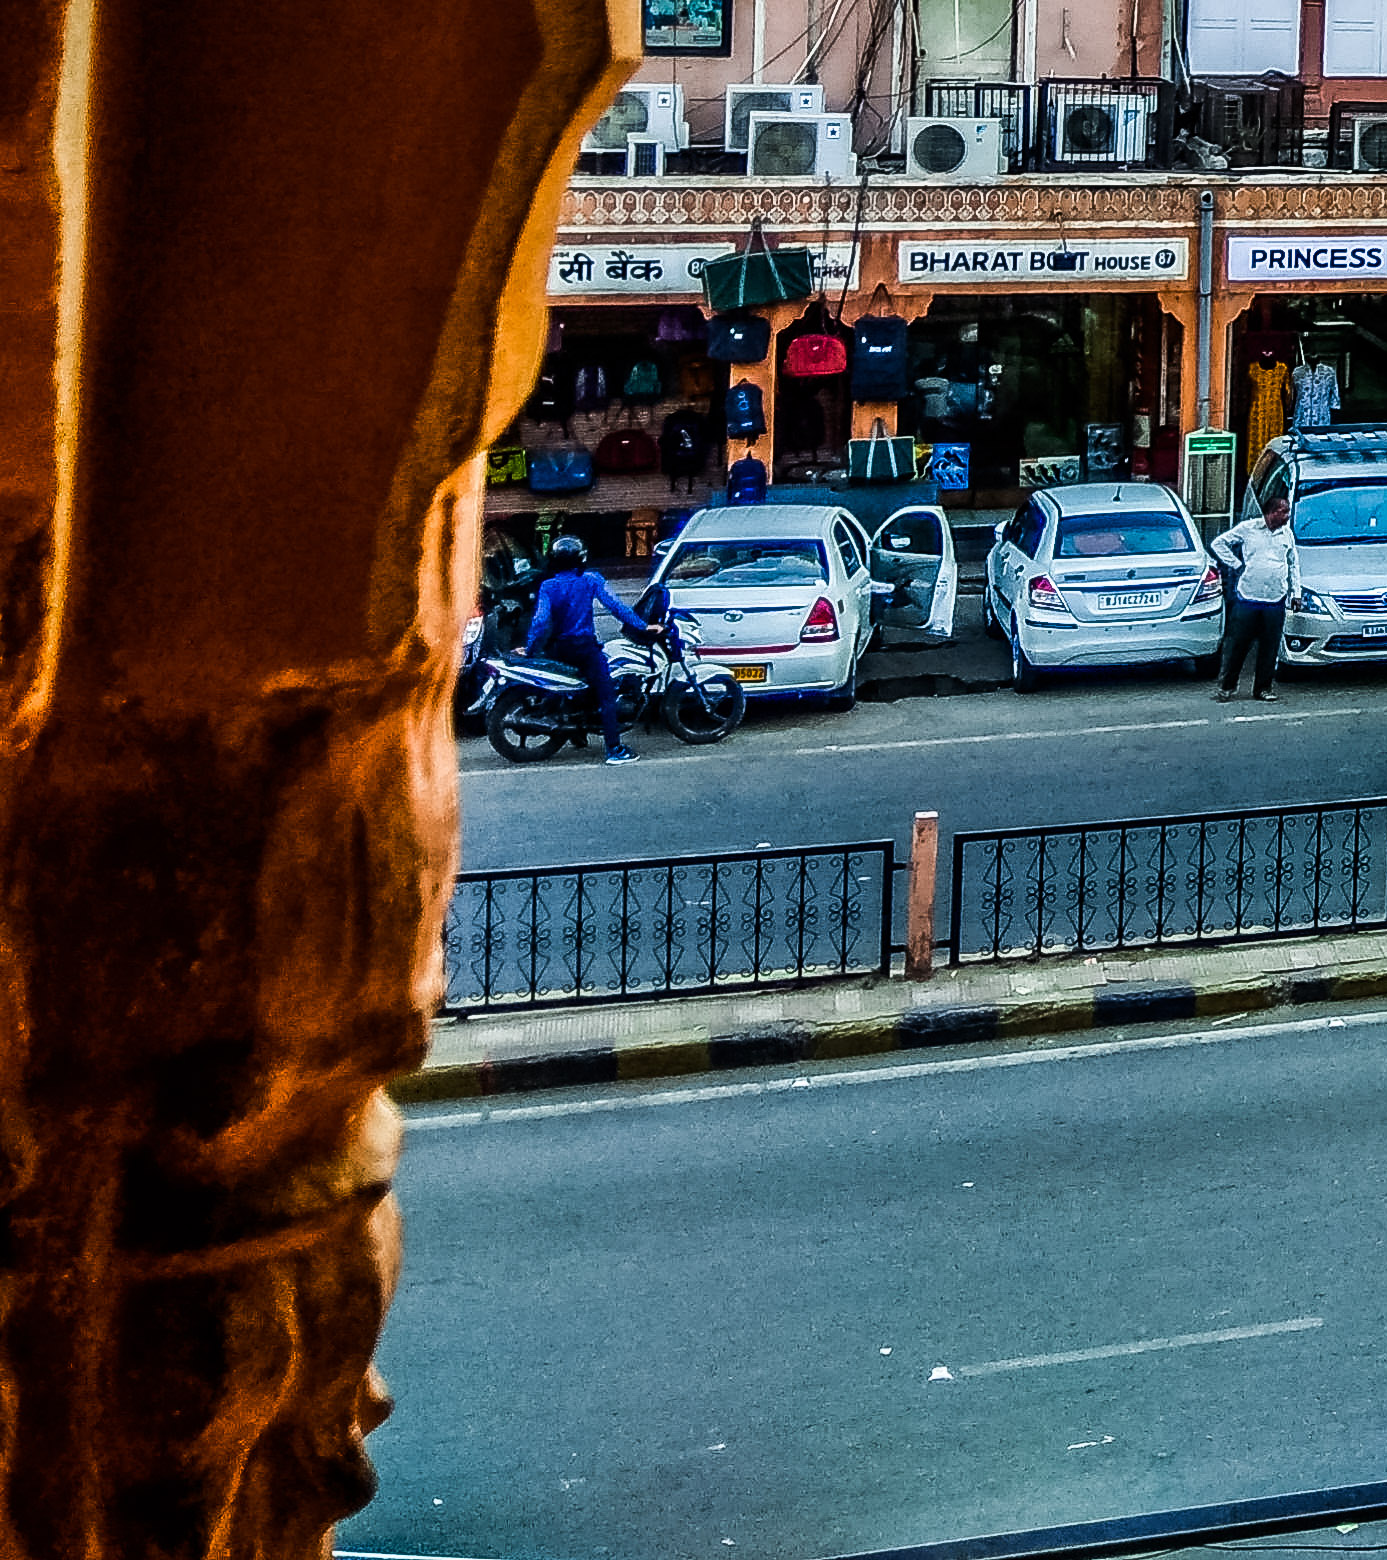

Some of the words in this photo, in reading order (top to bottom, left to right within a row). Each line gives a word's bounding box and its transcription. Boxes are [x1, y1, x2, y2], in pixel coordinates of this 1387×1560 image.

[605, 250, 662, 282] बैंक
[910, 251, 1023, 271] BHARAT
[1030, 251, 1089, 271] BOT
[1095, 256, 1150, 271] HOUSE
[1157, 250, 1175, 267] 87
[1251, 248, 1382, 269] PRINCESS
